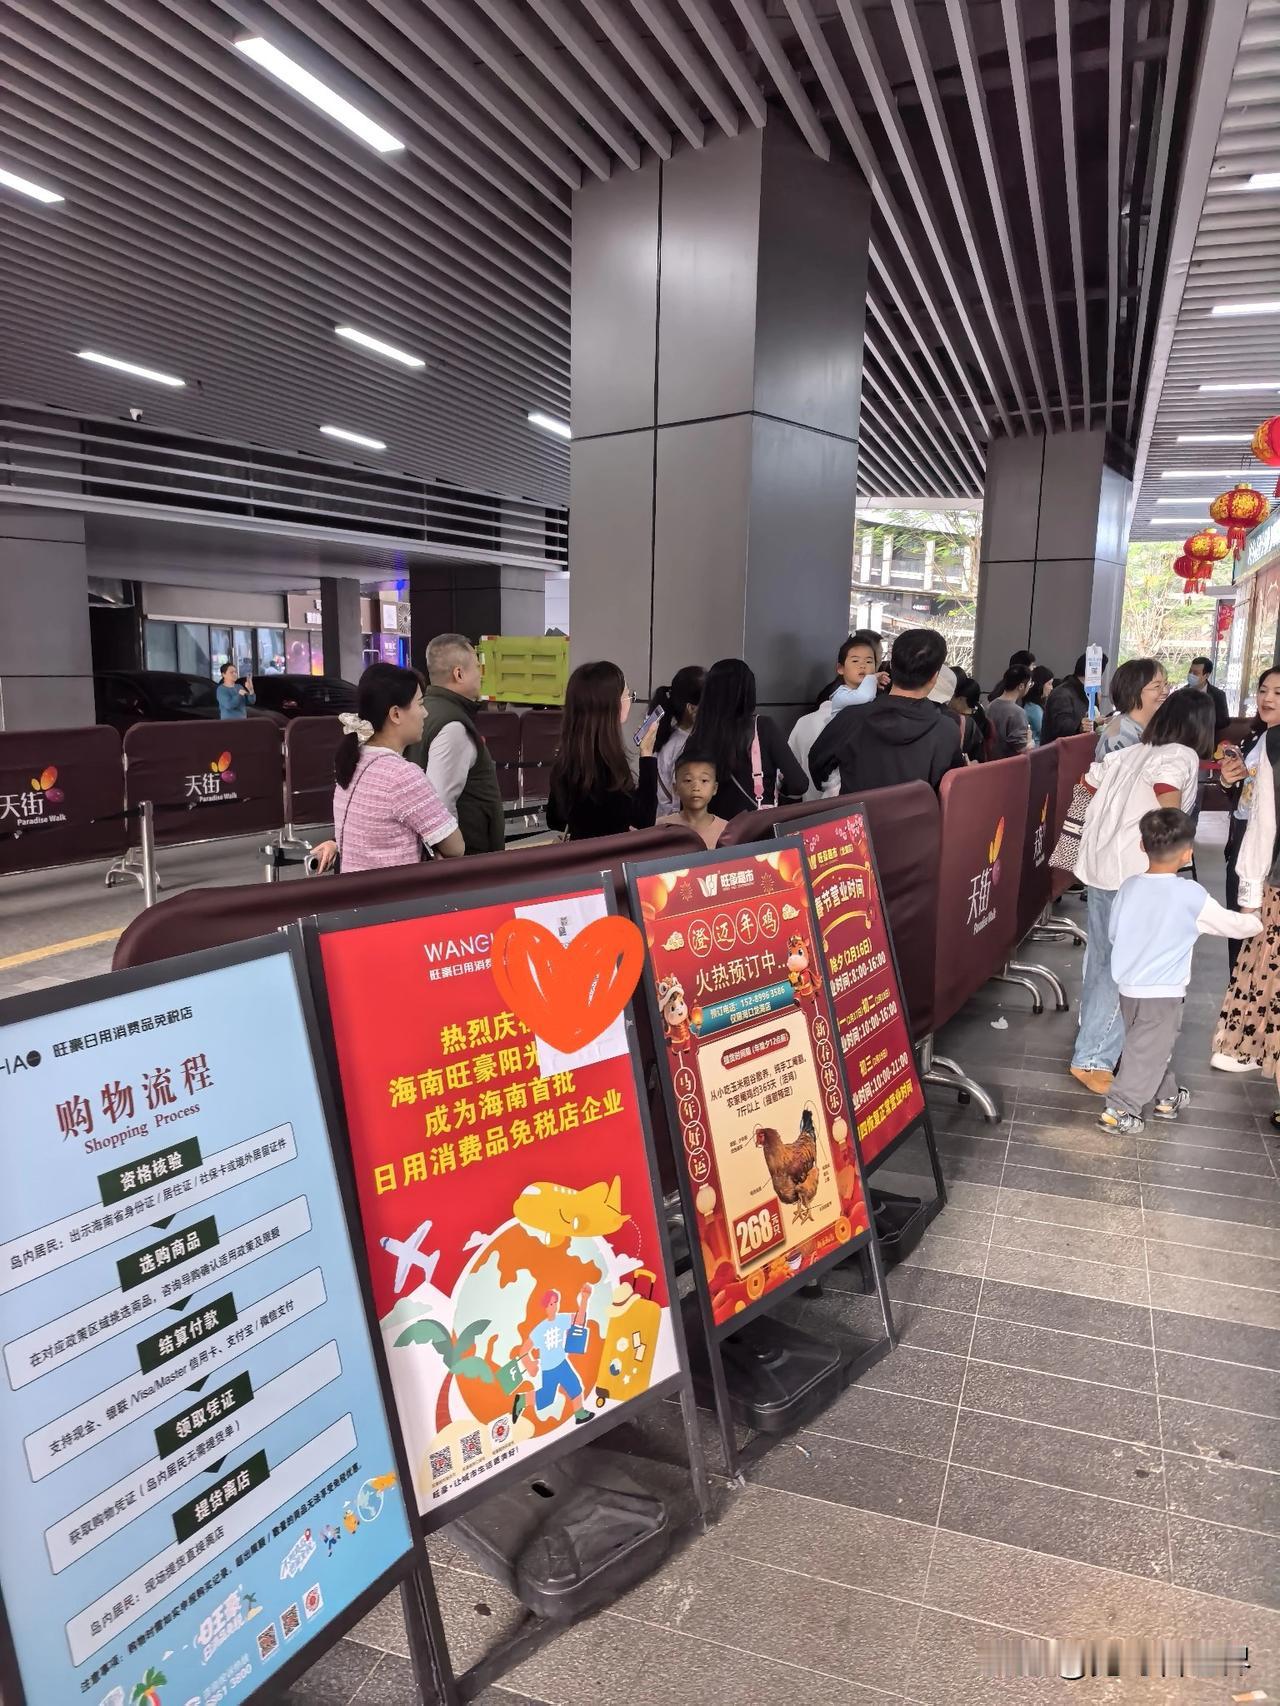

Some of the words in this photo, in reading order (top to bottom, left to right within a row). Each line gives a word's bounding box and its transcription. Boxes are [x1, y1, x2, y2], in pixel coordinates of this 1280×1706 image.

[0, 792, 44, 819] 天街
[185, 773, 220, 797] 天街
[199, 794, 223, 802] Paradise
[223, 792, 237, 800] Walk
[17, 815, 48, 827] Paradise
[49, 813, 66, 823] Walk
[814, 877, 865, 921] 春节营业时间
[966, 867, 993, 925] 天街
[424, 932, 494, 963] WANG
[692, 910, 777, 951] 澄迈年鸡
[53, 1006, 193, 1058] 旺豪日用消费品免税店
[55, 1053, 215, 1142] 购物流程
[425, 1070, 576, 1138] 成为海南首批
[84, 1121, 149, 1154] Shopping
[154, 1103, 200, 1128] Process
[374, 1088, 624, 1195] 日用消费品免税店企业
[680, 1073, 707, 1175] 马年好运
[119, 1152, 184, 1192] 资格核验
[138, 1230, 202, 1275] 选购商品
[736, 1208, 773, 1255] 268
[158, 1308, 219, 1356] 结算付款
[175, 1388, 236, 1439] 领取凭证
[194, 1470, 251, 1522] 提货离店
